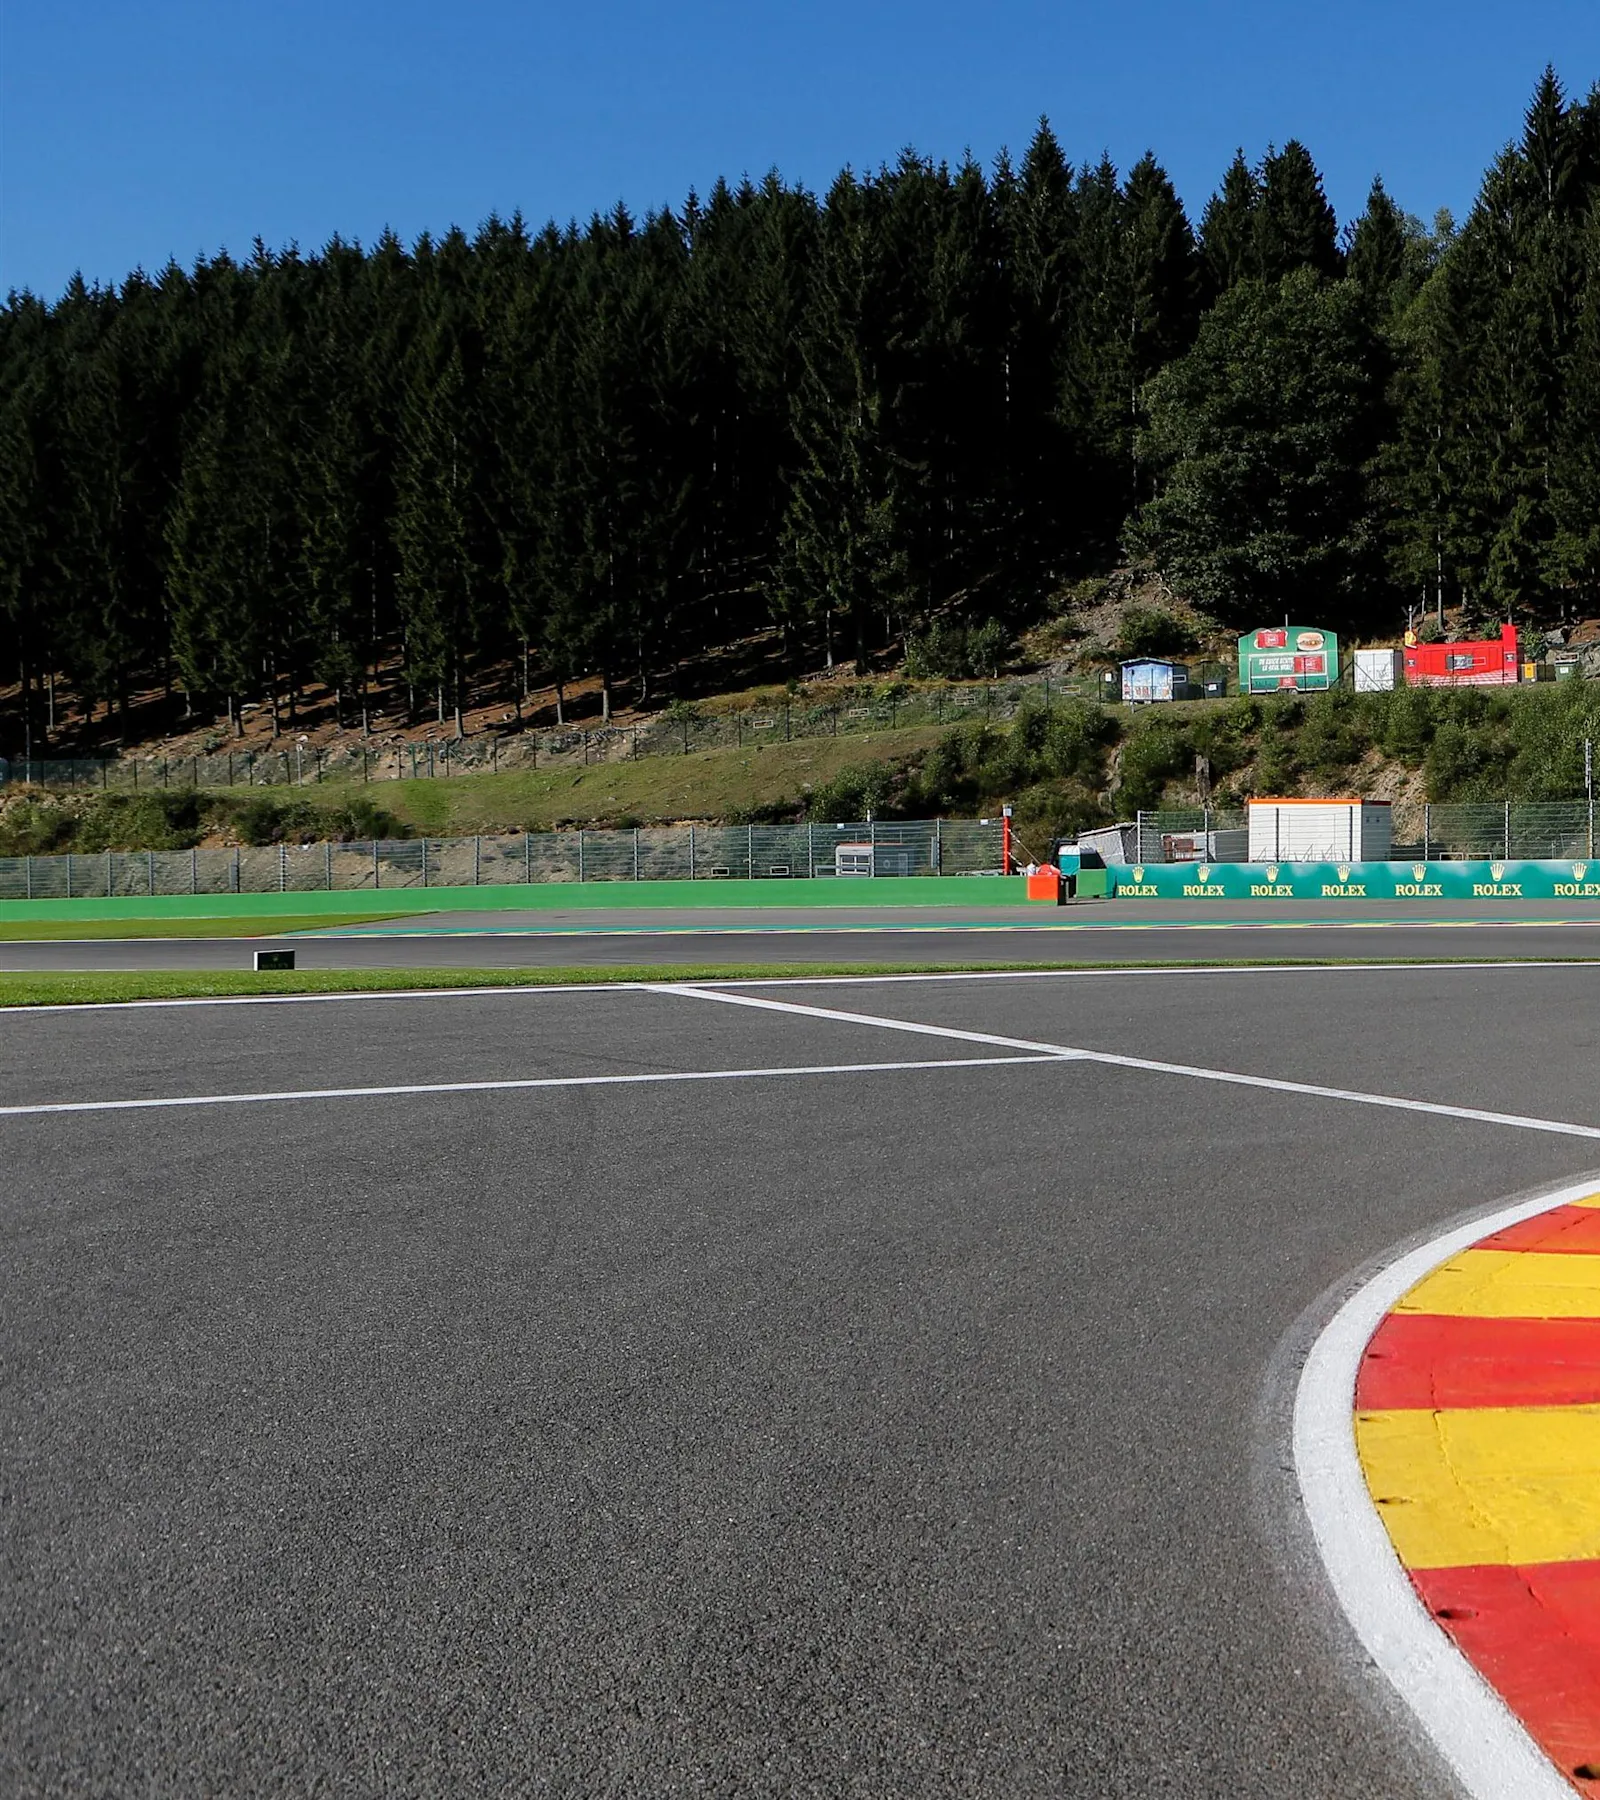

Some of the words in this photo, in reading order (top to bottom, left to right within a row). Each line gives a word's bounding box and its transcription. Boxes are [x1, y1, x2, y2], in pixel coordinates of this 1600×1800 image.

[1118, 885, 1158, 896] ROLEX
[1183, 885, 1224, 897] ROLEX
[1251, 885, 1293, 897] ROLEX
[1322, 884, 1365, 897] ROLEX
[1395, 884, 1442, 896] ROLEX
[1473, 884, 1521, 896] ROLEX
